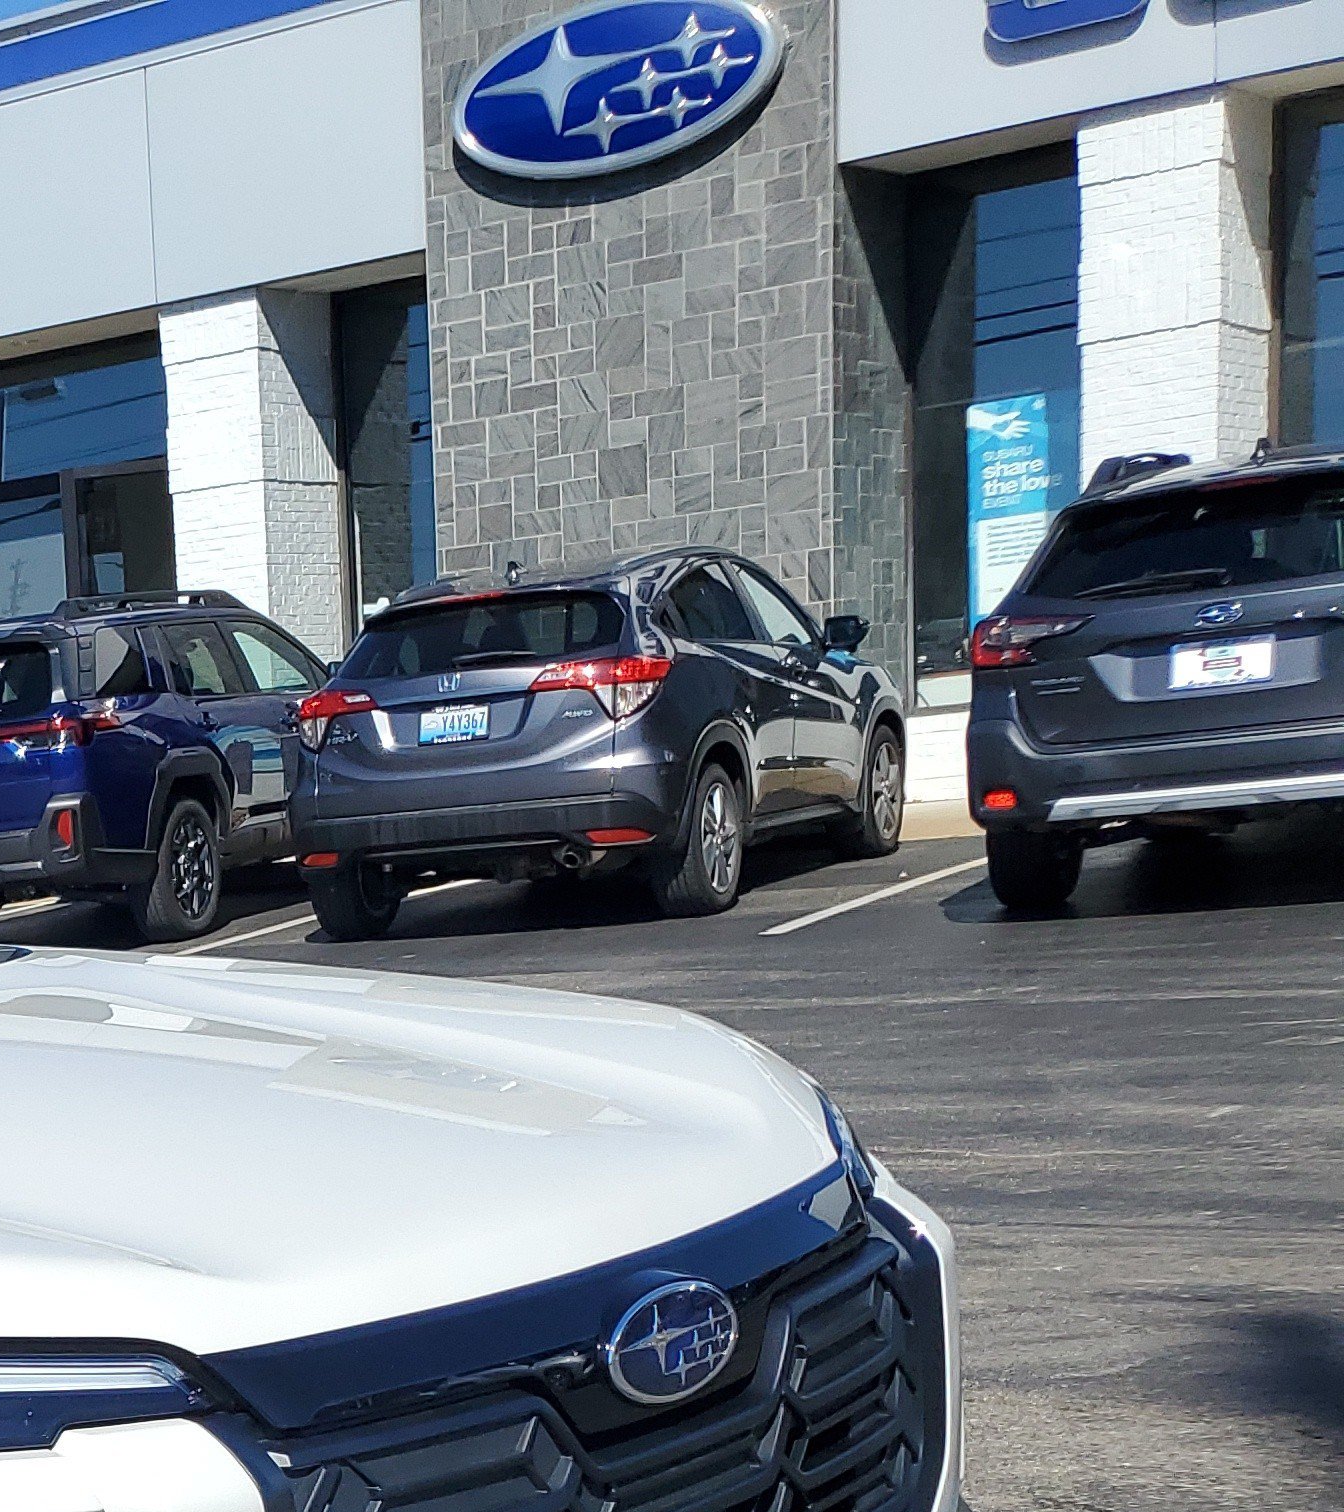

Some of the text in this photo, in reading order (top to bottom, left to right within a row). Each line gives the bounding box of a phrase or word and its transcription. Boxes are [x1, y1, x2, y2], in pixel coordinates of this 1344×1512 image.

[982, 458, 1044, 481] share
[982, 472, 1063, 498] the love
[441, 711, 486, 732] Y4Y367
